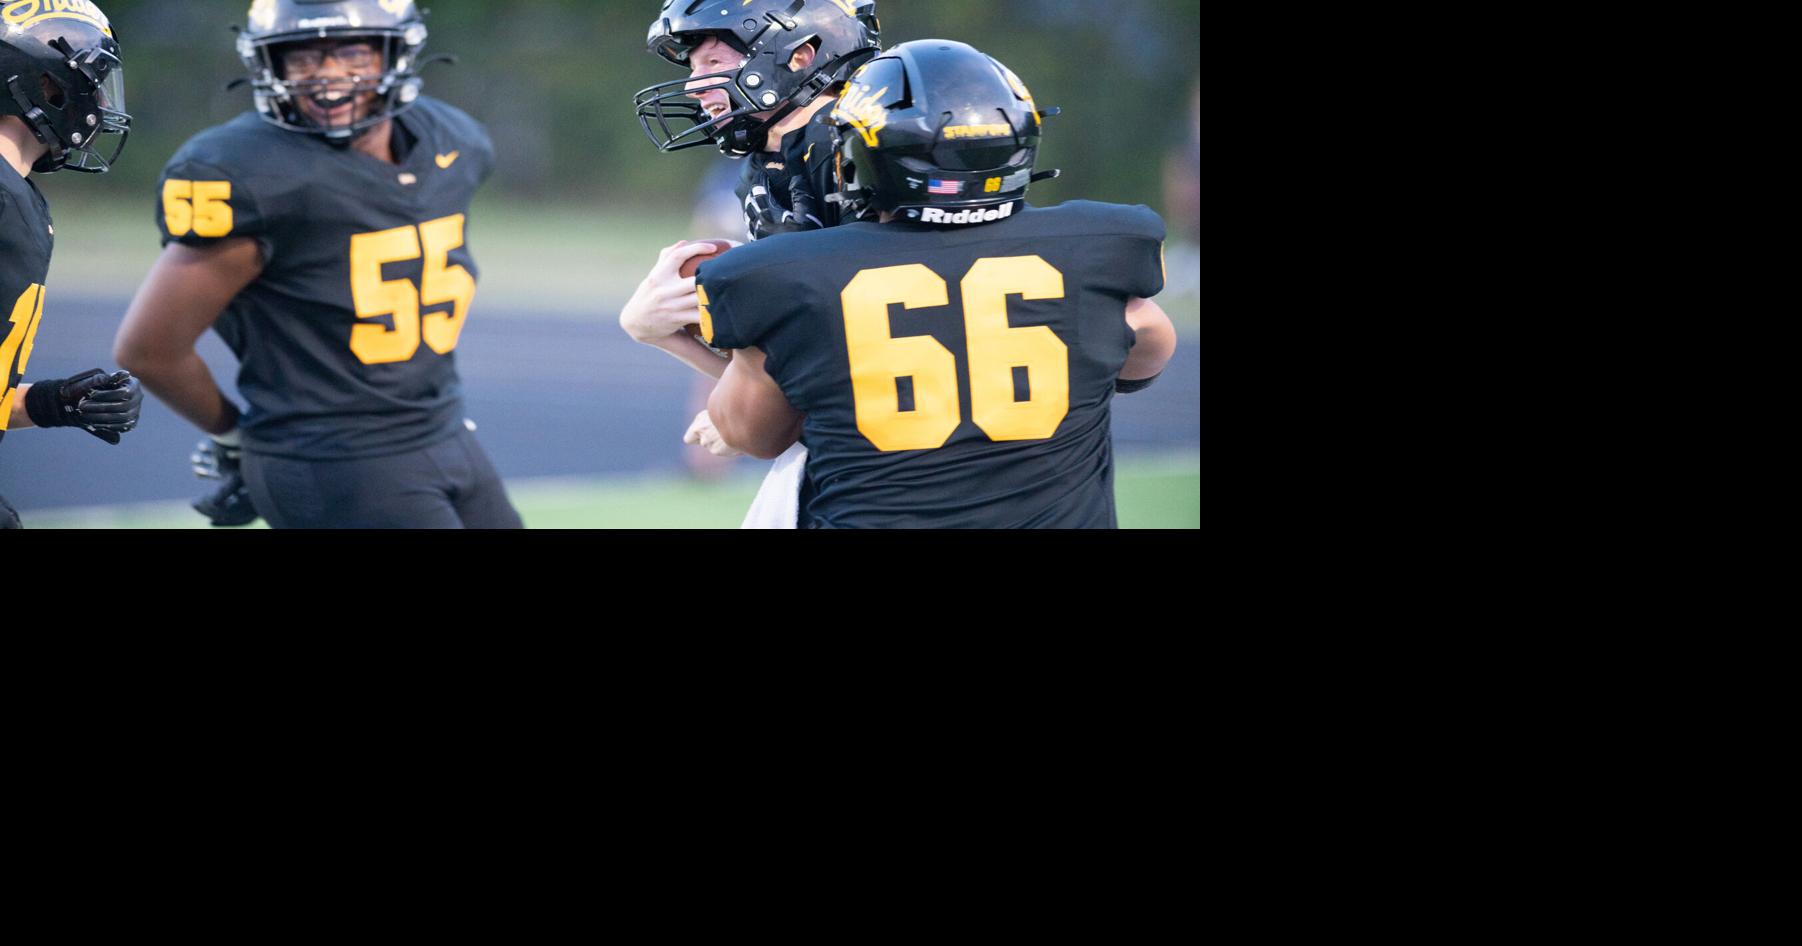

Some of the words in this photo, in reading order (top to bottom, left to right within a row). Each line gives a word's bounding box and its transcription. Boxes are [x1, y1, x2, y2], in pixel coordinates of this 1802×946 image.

[162, 178, 233, 237] 55
[921, 202, 1014, 224] Riddell
[350, 213, 476, 365] 55
[840, 254, 1069, 452] 66
